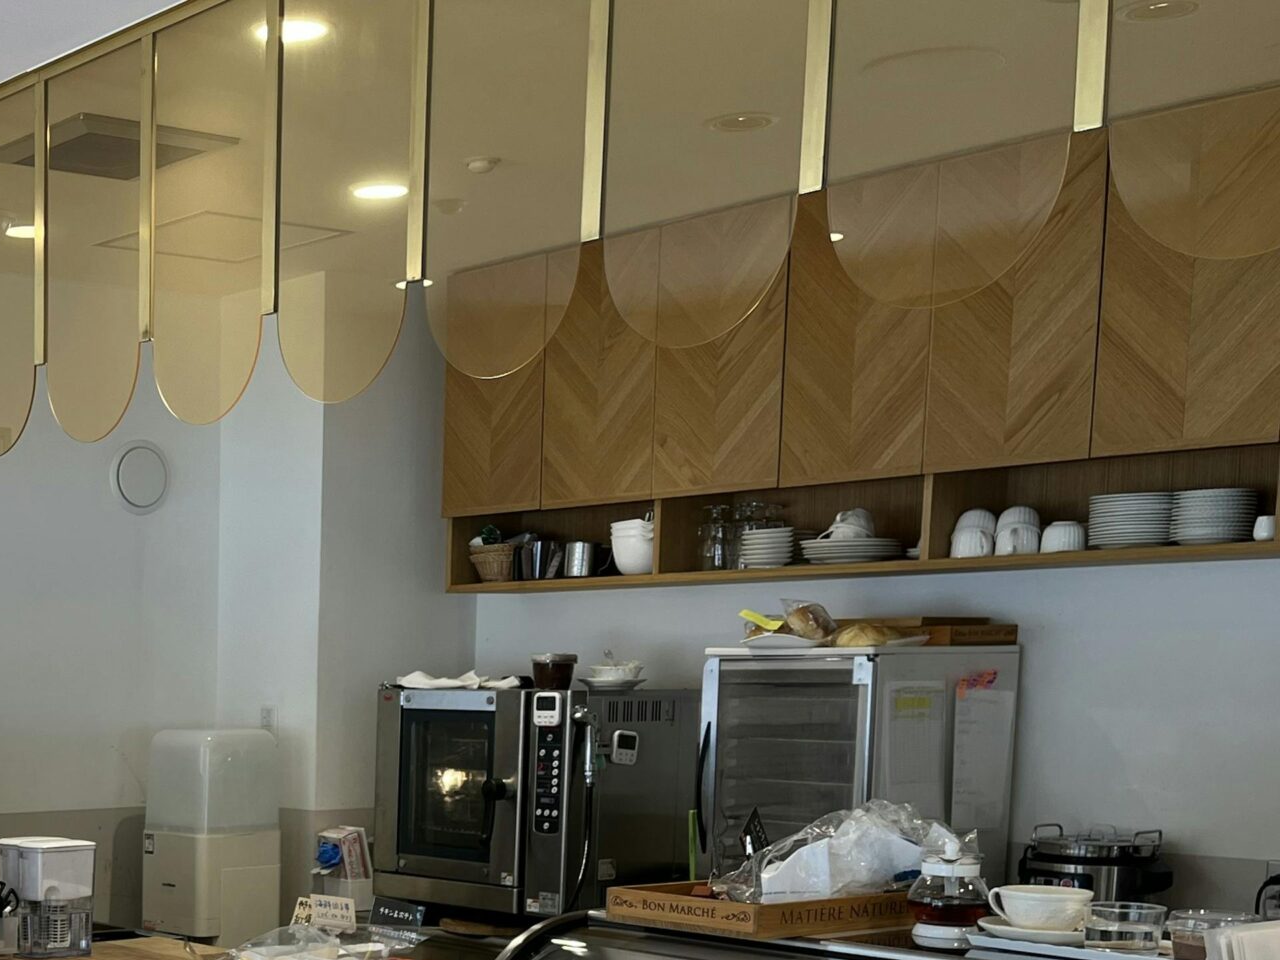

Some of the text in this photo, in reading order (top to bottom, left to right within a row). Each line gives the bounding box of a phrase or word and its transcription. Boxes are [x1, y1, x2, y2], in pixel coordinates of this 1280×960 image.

[641, 899, 718, 919] BON MARCHÉ
[780, 905, 845, 926] MATIÈRE
